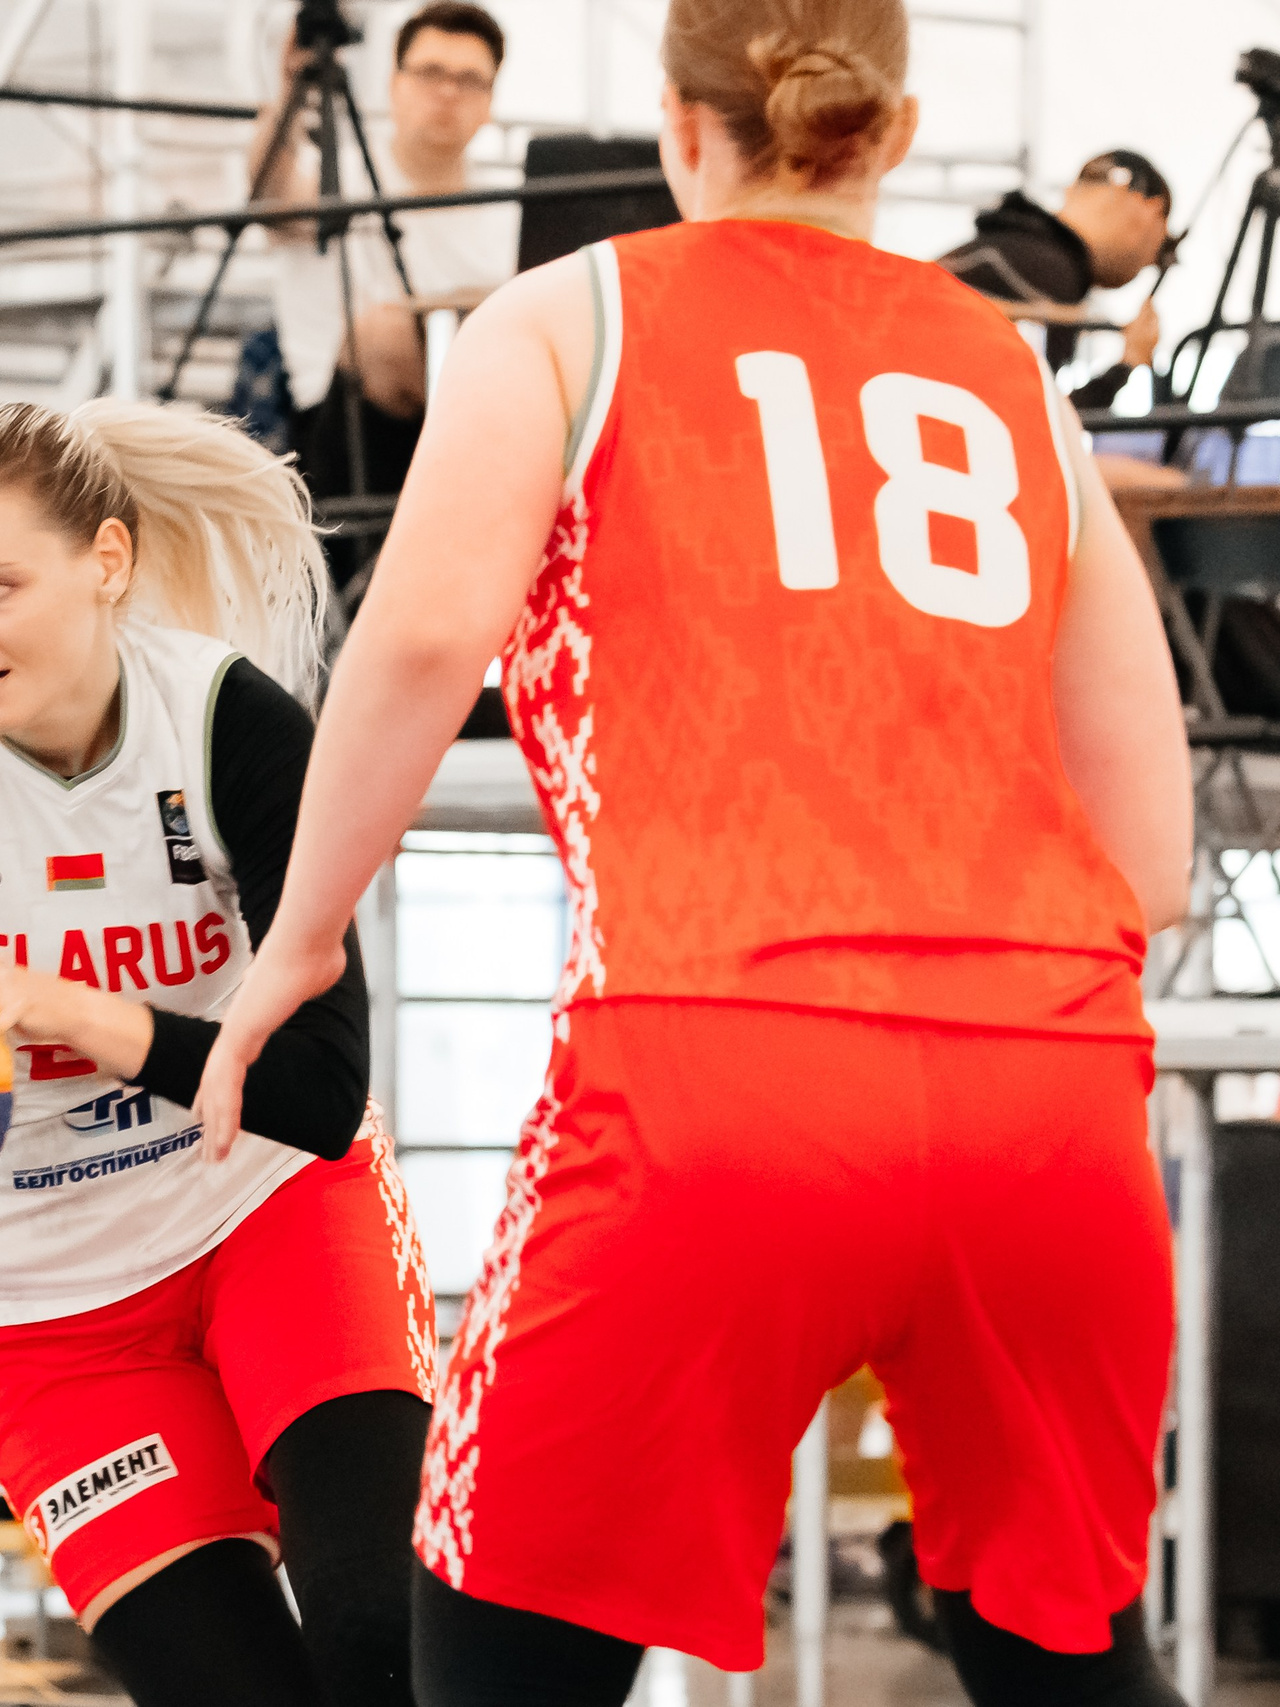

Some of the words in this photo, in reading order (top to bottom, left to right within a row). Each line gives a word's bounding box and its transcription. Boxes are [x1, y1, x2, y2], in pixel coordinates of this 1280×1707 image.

[734, 350, 1031, 628] 18
[68, 1087, 153, 1132] ГП
[13, 1129, 205, 1190] БЕЛГОСПИЩЕПР
[47, 1443, 159, 1524] ЭЛЕМЕНТ
